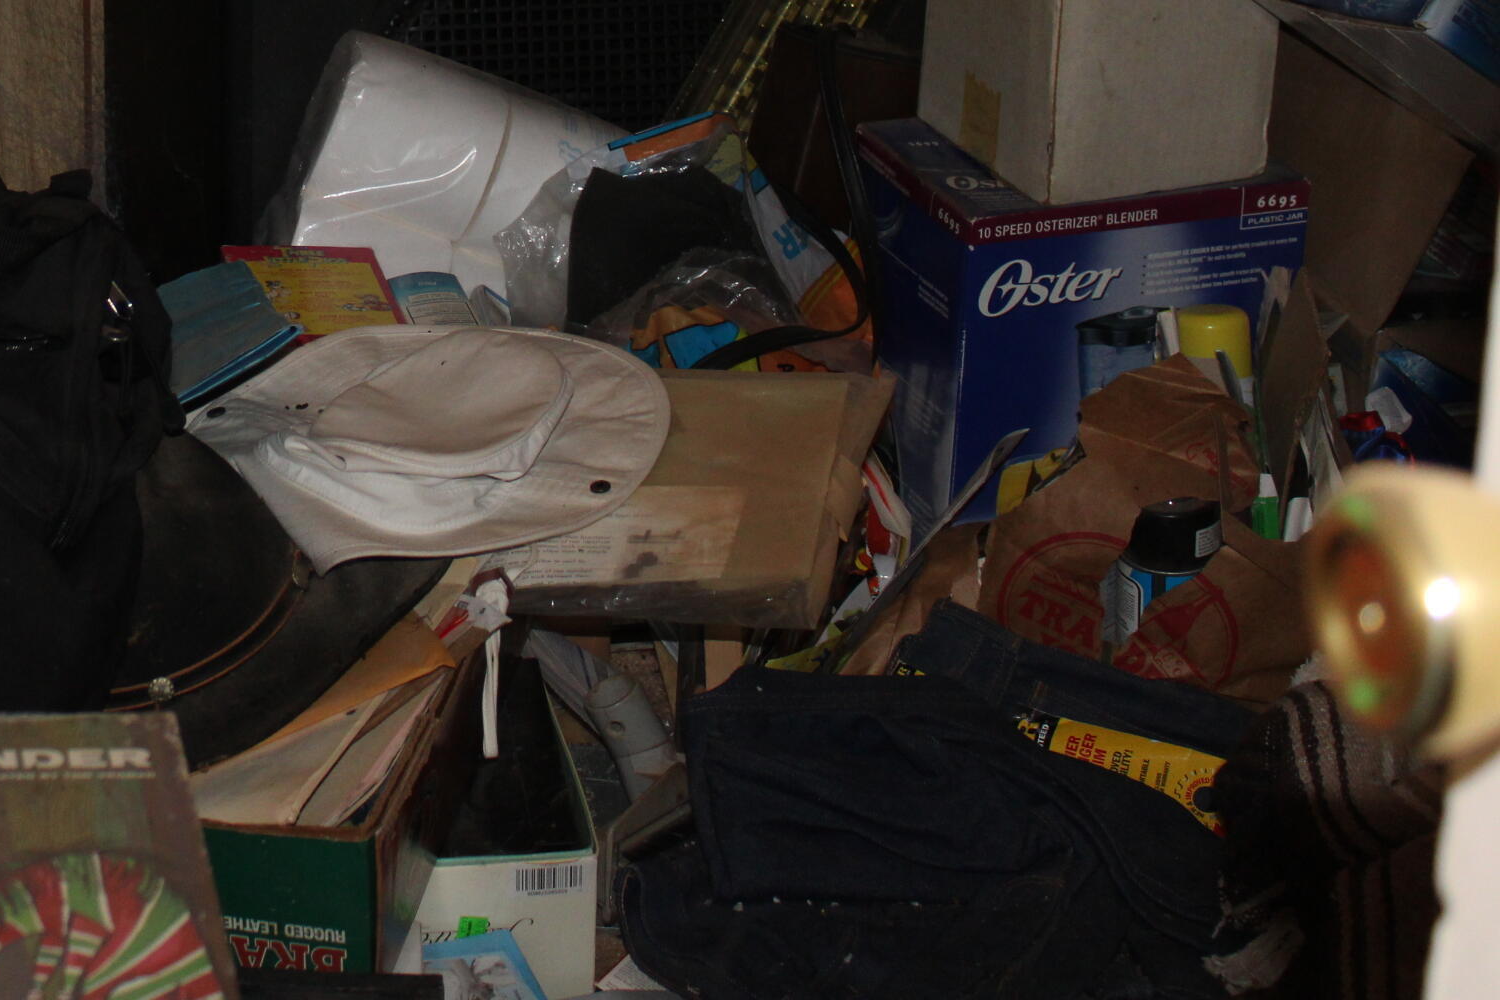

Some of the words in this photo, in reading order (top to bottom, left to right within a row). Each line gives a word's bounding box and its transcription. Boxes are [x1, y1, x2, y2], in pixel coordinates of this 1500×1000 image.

[1256, 194, 1299, 209] 6695
[937, 207, 961, 236] 6695
[977, 227, 992, 240] 10
[994, 221, 1033, 238] SPEED
[1106, 208, 1159, 226] BLENDER
[1247, 213, 1284, 225] PLASTIC
[1286, 211, 1304, 222] JAR
[977, 258, 1125, 318] Oster
[1018, 589, 1097, 652] TRA
[1064, 735, 1081, 756] IER
[1091, 747, 1107, 766] IM
[223, 915, 279, 936] LEATHE
[284, 923, 347, 944] RUGGED
[228, 933, 348, 973] BRA
